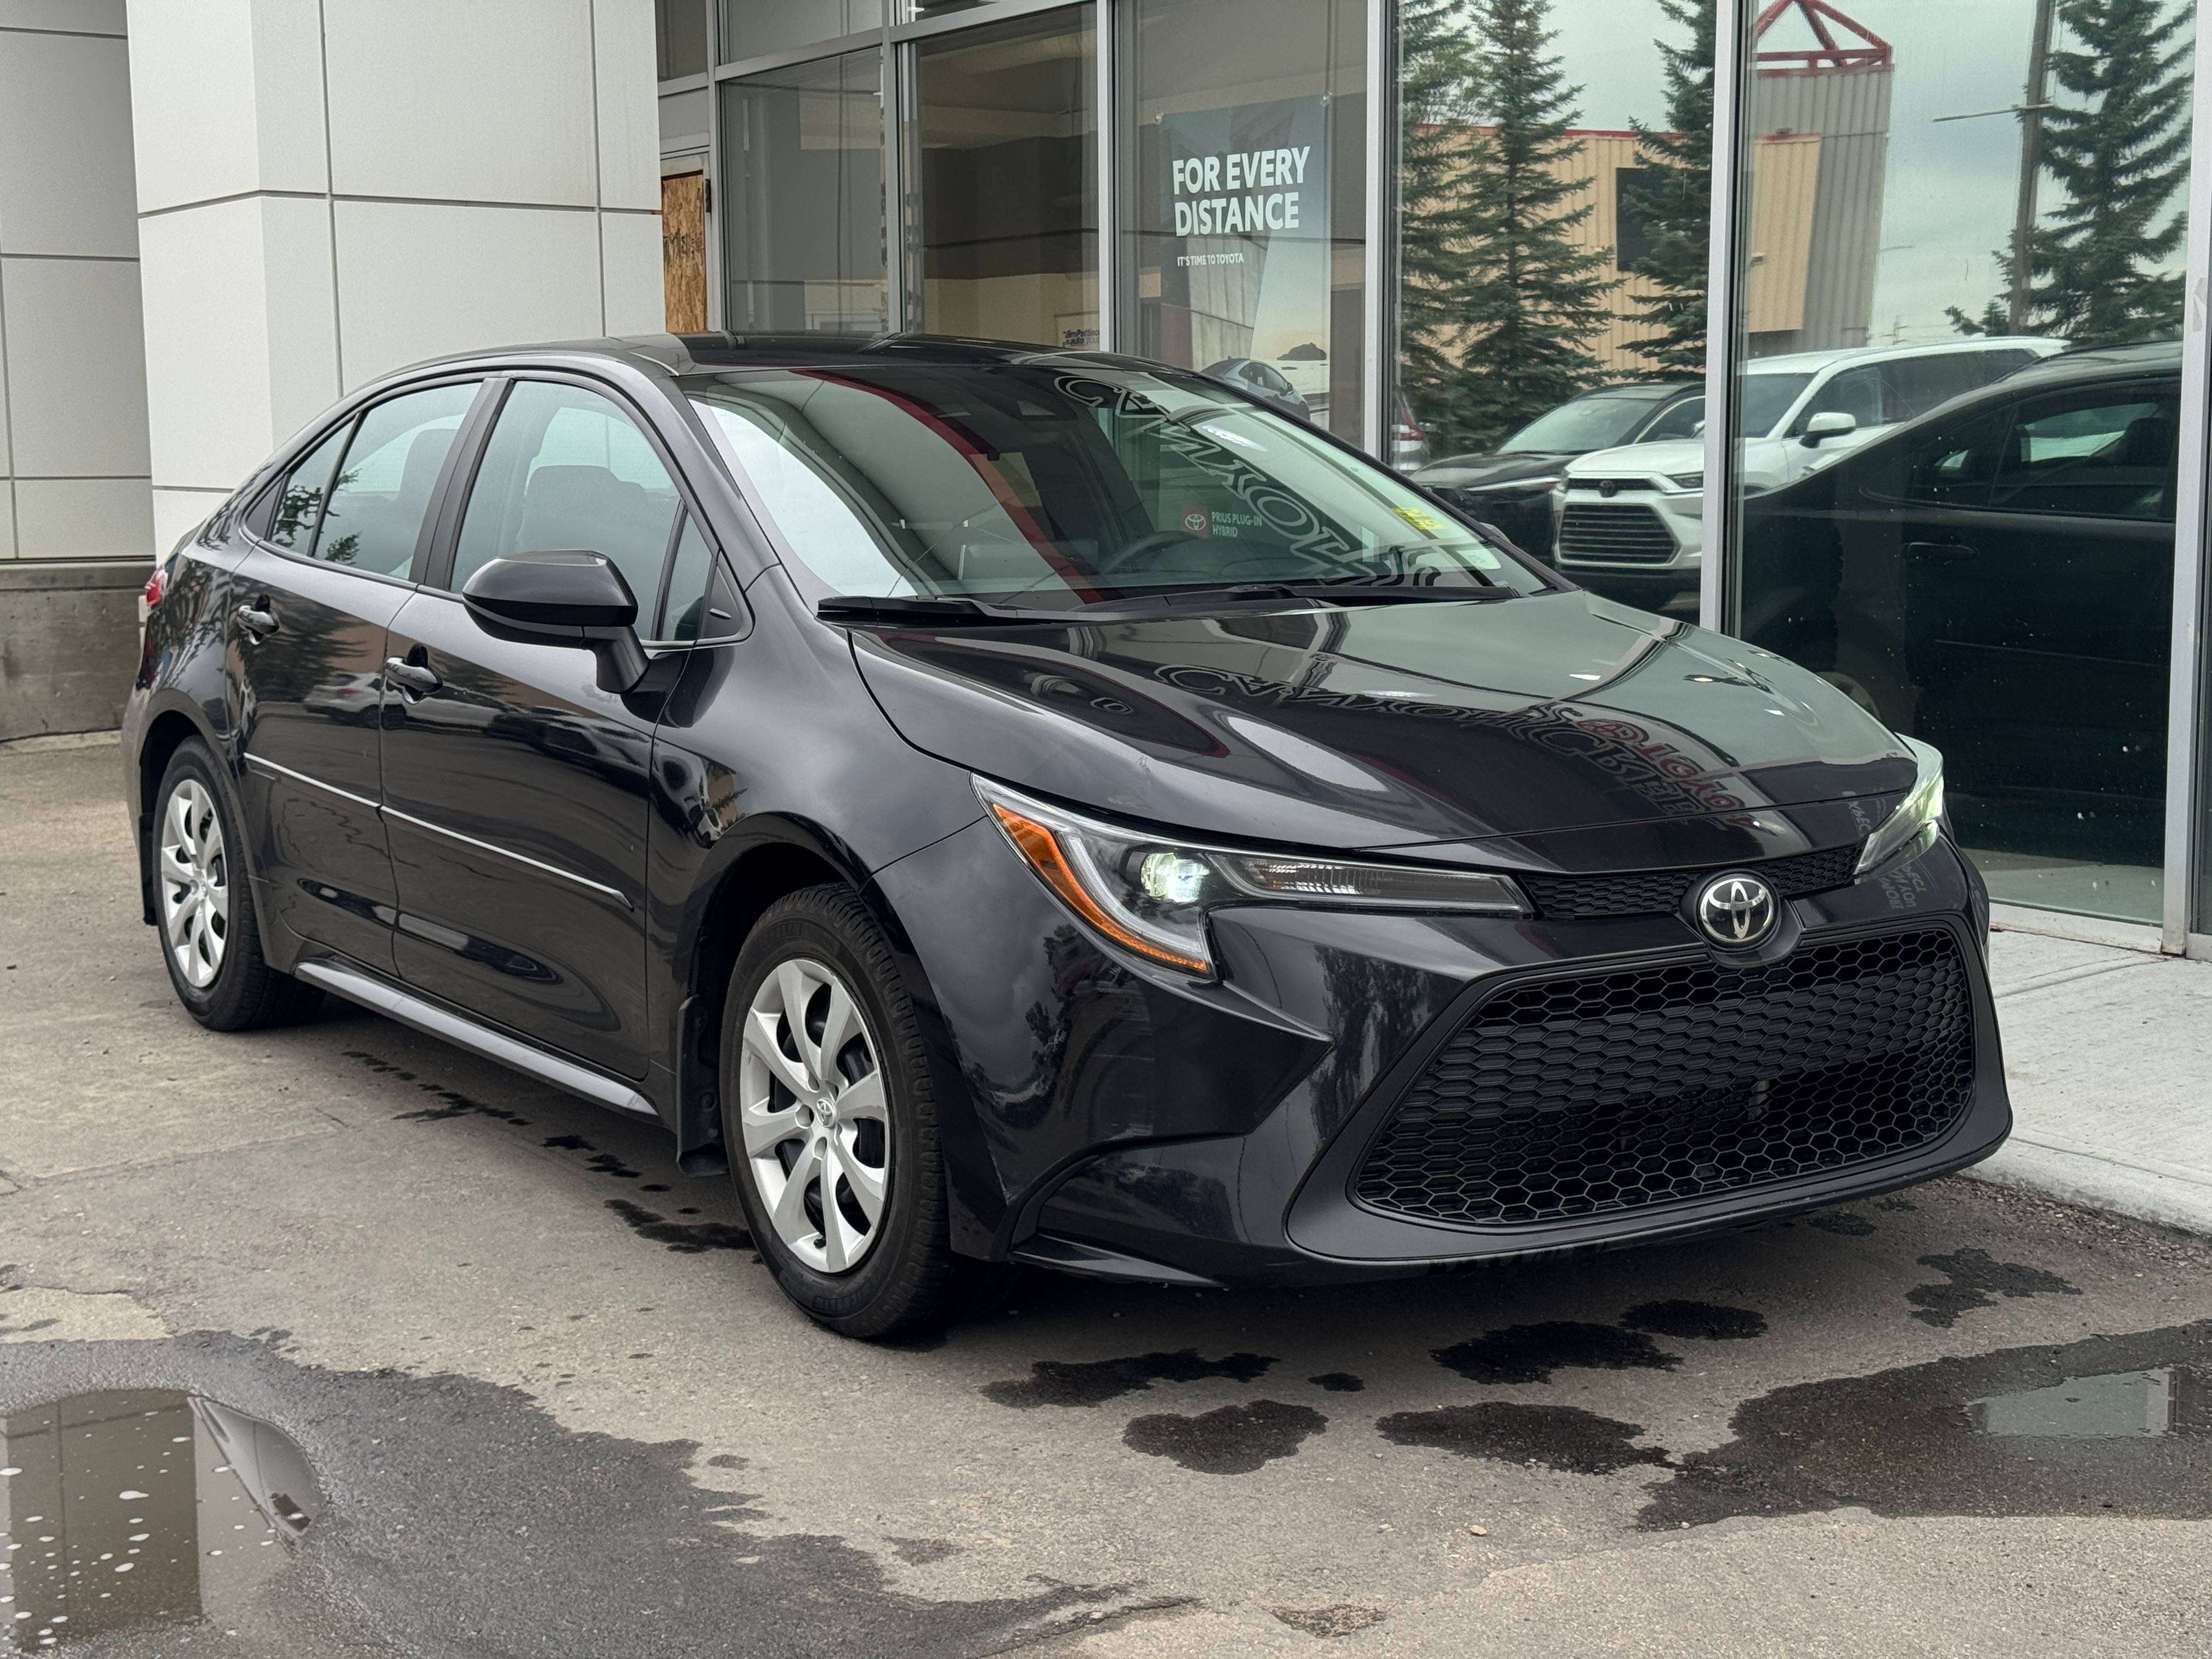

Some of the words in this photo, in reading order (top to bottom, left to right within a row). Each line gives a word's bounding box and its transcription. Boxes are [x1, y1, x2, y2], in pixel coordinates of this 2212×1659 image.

[1172, 156, 1221, 195] FOR
[1226, 145, 1311, 190] EVERY
[1174, 191, 1299, 237] DISTANCE
[1190, 255, 1206, 266] TIME
[1207, 254, 1216, 264] TO
[1216, 253, 1244, 264] TOYOTA
[1211, 511, 1233, 523] PRIUS
[1233, 514, 1262, 527] PLUG-IN
[1212, 524, 1238, 537] HYBRID
